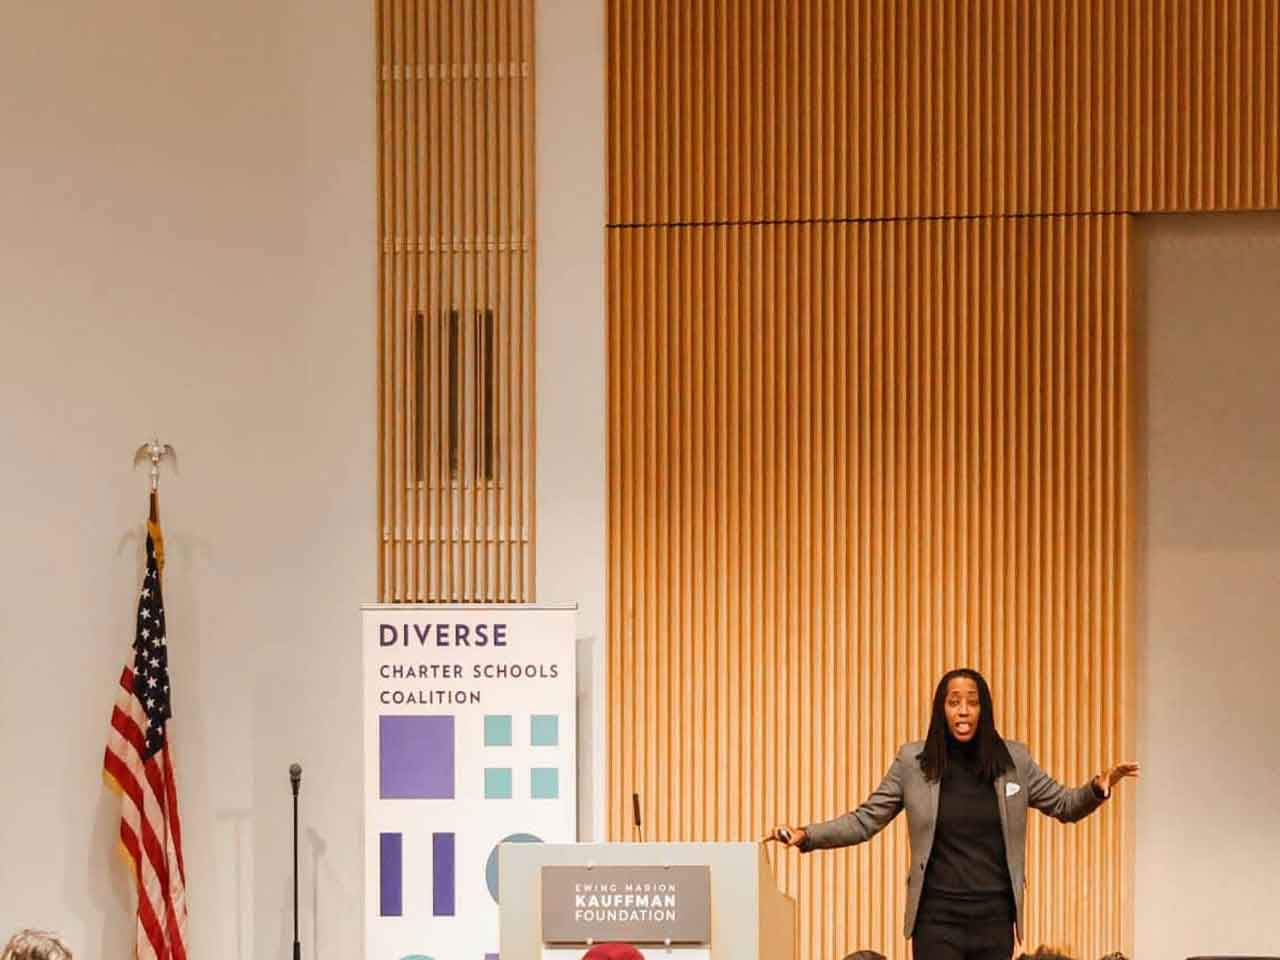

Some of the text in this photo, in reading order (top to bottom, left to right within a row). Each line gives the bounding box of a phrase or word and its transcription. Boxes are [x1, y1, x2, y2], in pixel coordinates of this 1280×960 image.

[379, 623, 507, 647] DIVERSE
[379, 663, 559, 679] CHARTER SCHOOLS
[379, 690, 481, 705] COALITION
[575, 883, 676, 893] EWING MARION
[575, 894, 676, 908] KAUFFMAN
[575, 909, 676, 922] FOUNDATION
